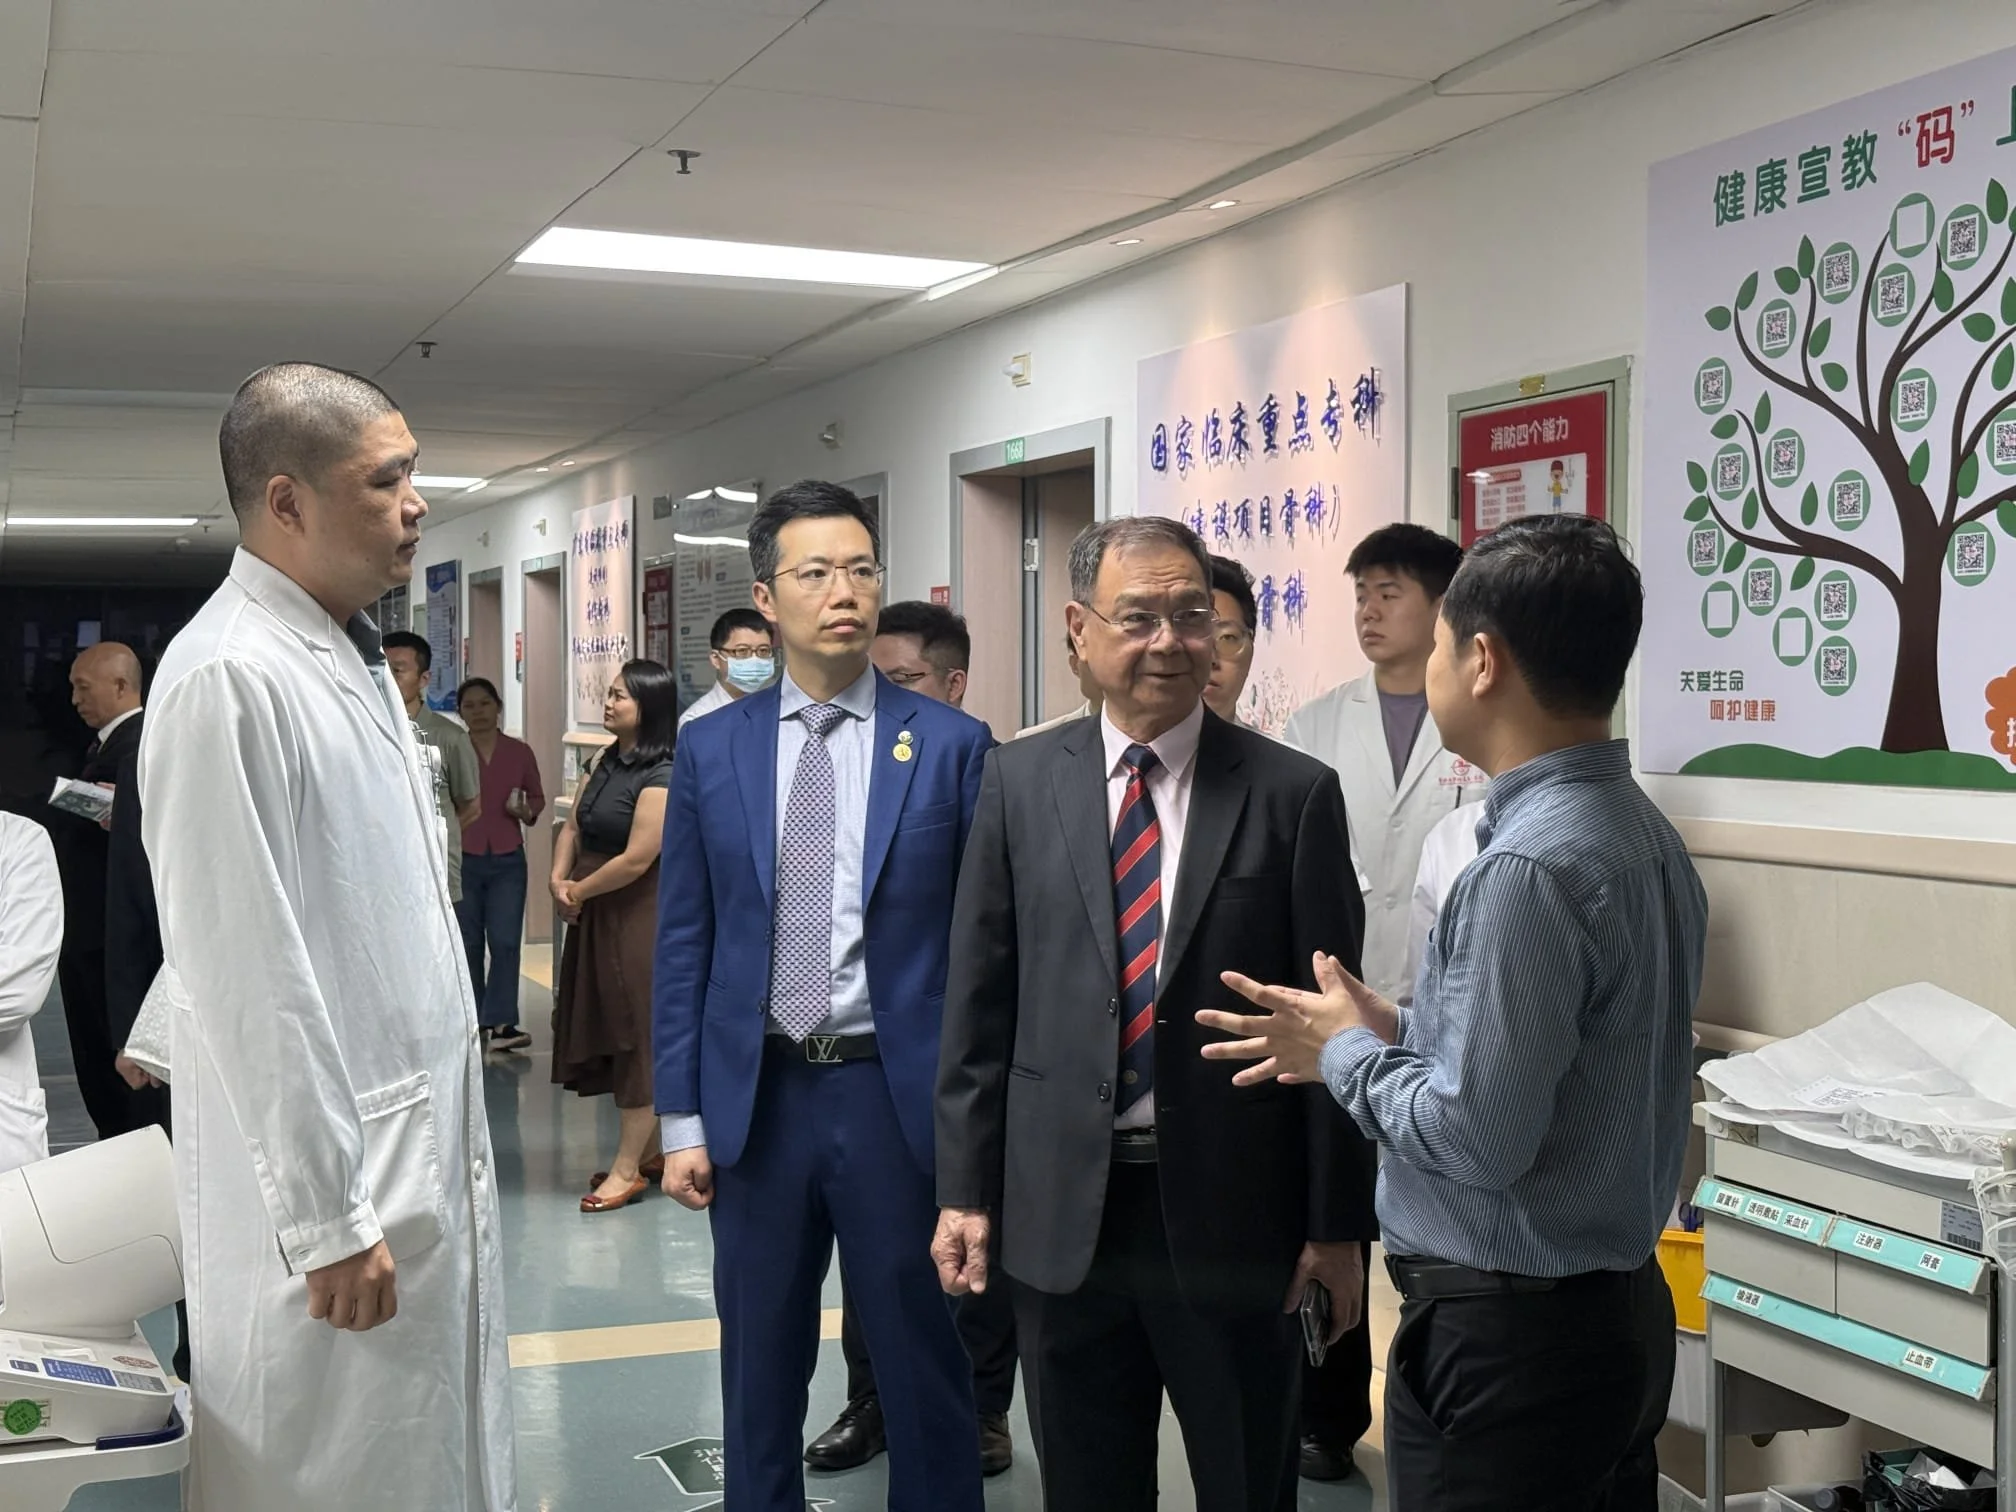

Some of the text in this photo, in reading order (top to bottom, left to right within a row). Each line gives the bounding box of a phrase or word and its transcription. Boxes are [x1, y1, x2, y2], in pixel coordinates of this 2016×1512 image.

[1151, 367, 1380, 471] 国家临床重点专科
[1491, 416, 1569, 451] 消防四个能力
[1710, 700, 1776, 721] 呵护健康
[1784, 1214, 1809, 1230] 采血针
[1856, 1233, 1941, 1269] 注射器 网套
[1905, 1351, 1934, 1368] 止血带
